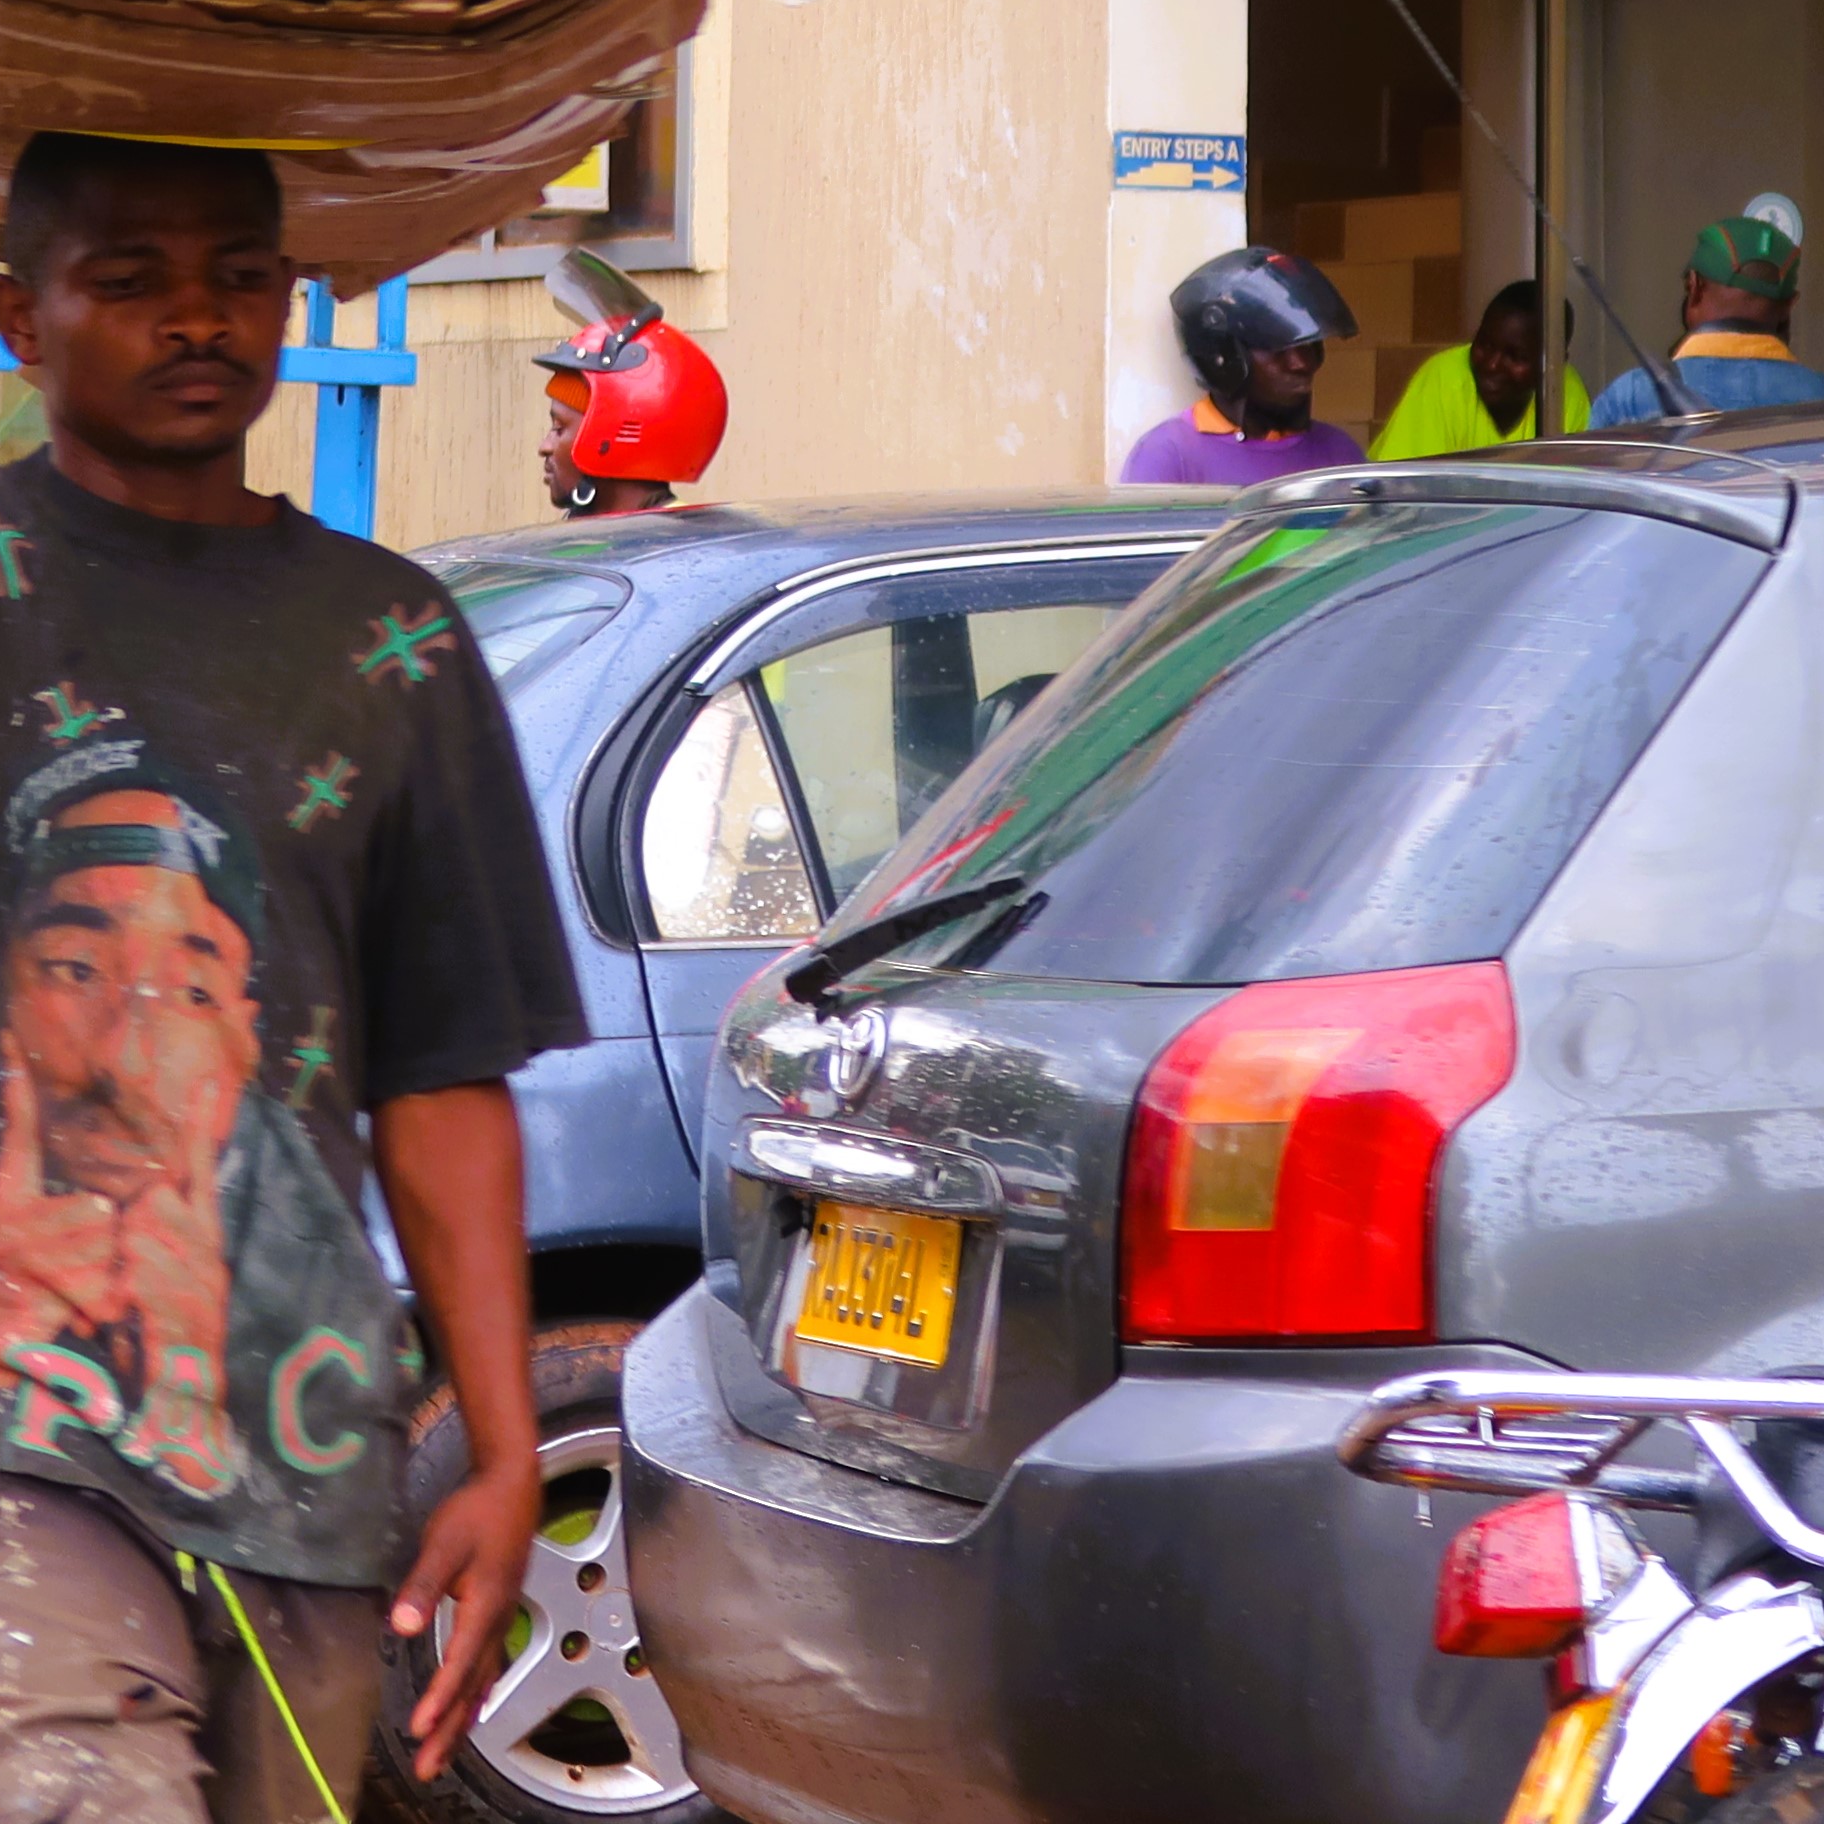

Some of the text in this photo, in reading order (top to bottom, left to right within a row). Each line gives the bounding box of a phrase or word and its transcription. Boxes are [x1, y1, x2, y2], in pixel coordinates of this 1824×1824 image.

[1120, 136, 1240, 162] ENTRY STEPS A
